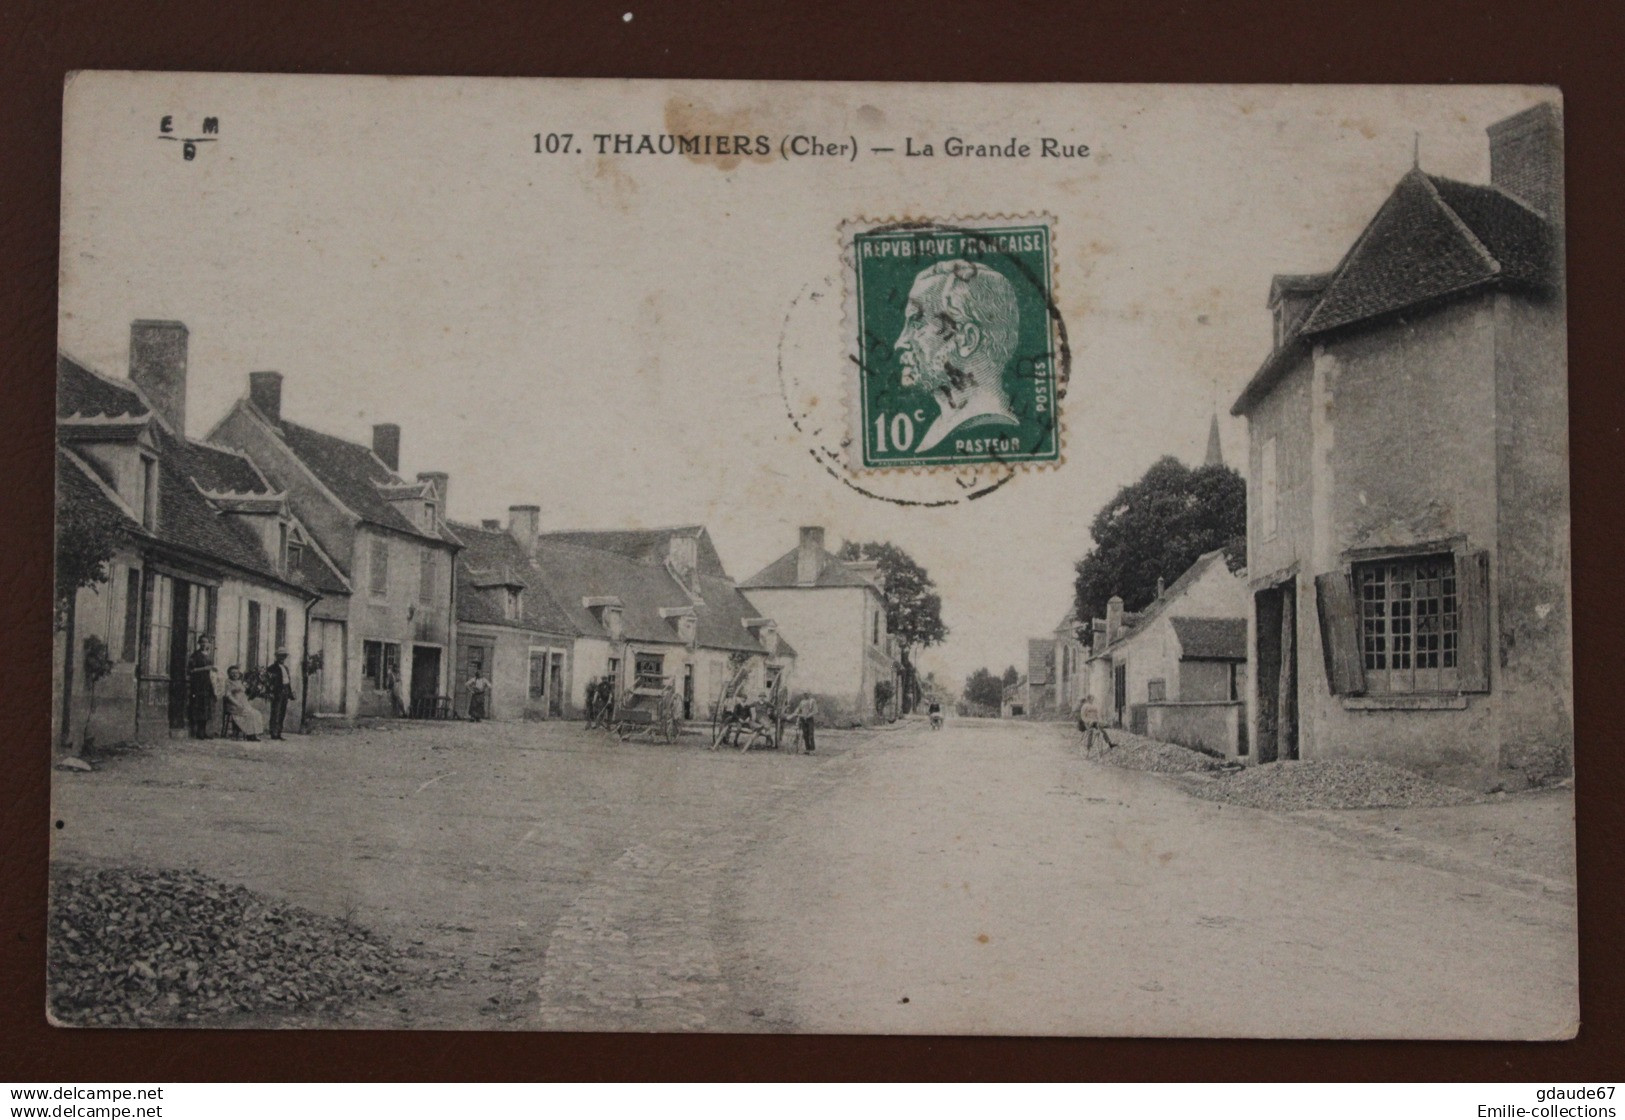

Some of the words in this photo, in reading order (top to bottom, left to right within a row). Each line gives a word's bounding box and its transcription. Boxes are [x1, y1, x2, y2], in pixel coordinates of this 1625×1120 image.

[533, 133, 582, 154] 107.
[593, 133, 771, 156] THAUMIERS
[780, 134, 858, 162] (Cher)
[905, 136, 934, 157] La
[944, 136, 1031, 158] Grande
[1040, 137, 1091, 158] Rue
[1034, 361, 1047, 413] POSTES
[955, 438, 1021, 453] PASTEUR
